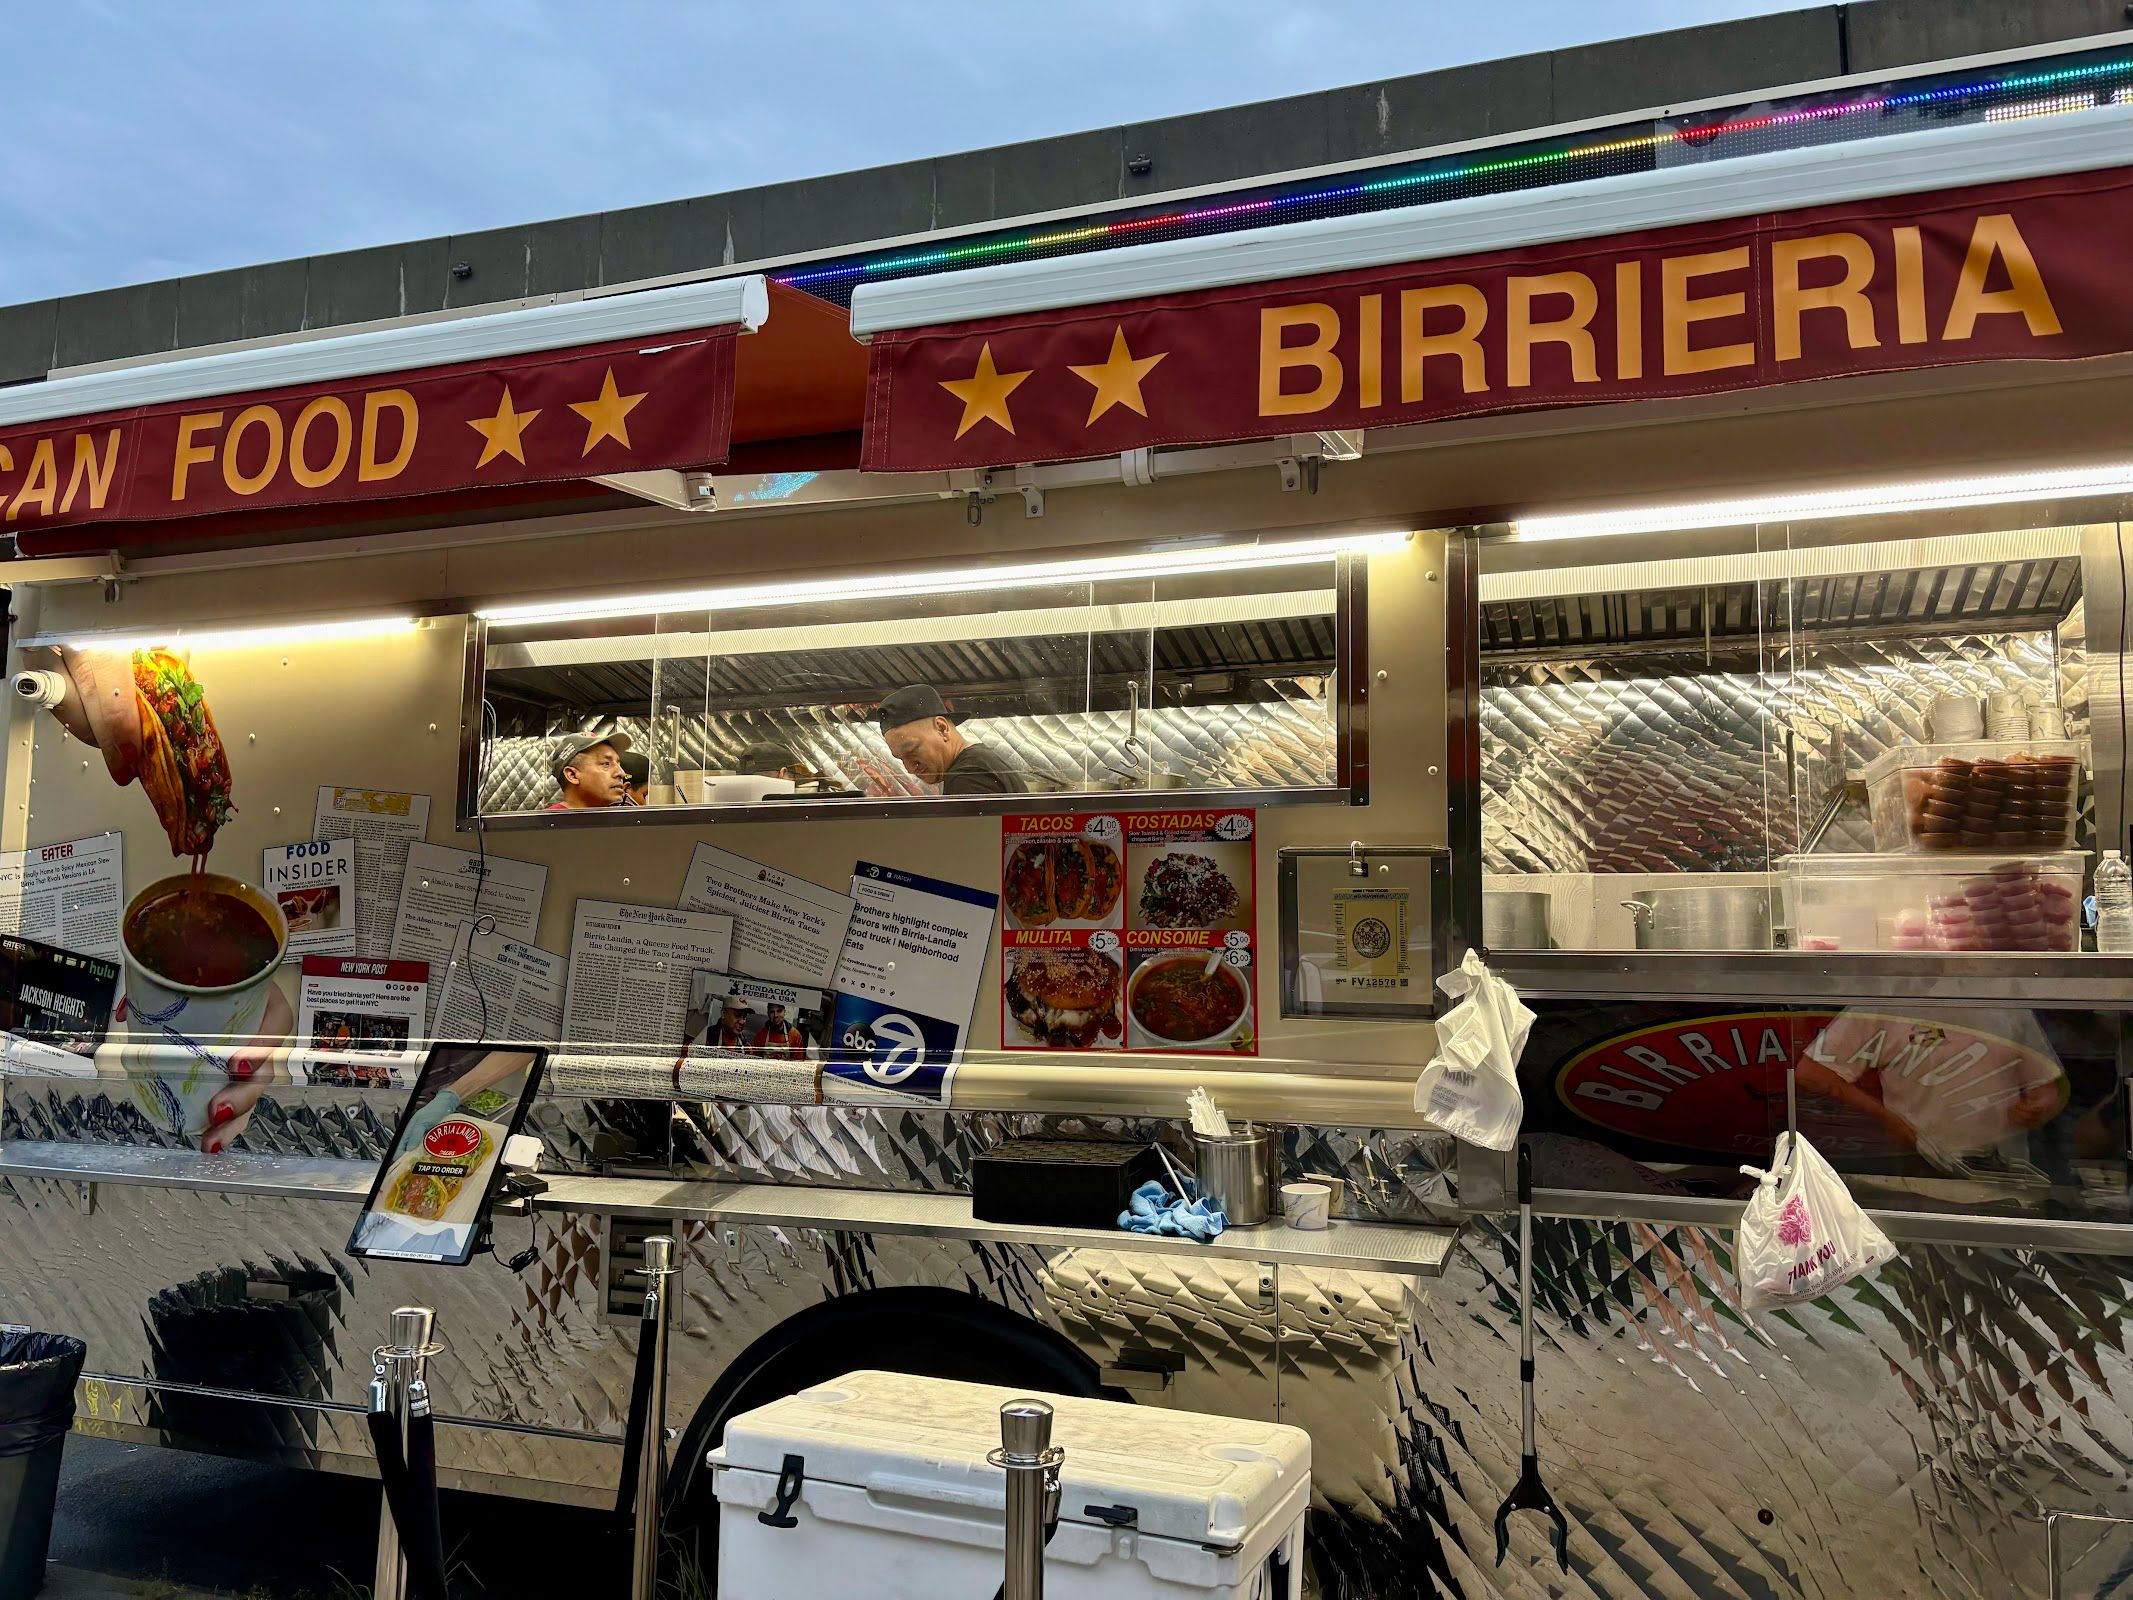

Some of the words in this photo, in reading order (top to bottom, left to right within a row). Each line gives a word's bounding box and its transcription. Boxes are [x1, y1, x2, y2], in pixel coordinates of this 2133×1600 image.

[1258, 213, 2064, 417] BIRRIERIA
[171, 388, 419, 501] FOOD
[1020, 816, 1074, 831] TACOS
[1127, 813, 1216, 830] TOSTADAS
[41, 844, 74, 861] EATER
[286, 841, 331, 860] FOOD
[61, 864, 75, 874] Spicy
[76, 859, 97, 869] Mexican
[62, 871, 82, 880] Versions
[88, 867, 96, 875] LA
[269, 857, 348, 883] INSIDER
[467, 865, 492, 877] STRET
[706, 875, 722, 888] Two
[723, 880, 758, 901] Brothers
[759, 895, 781, 910] Make
[782, 903, 800, 917] New
[802, 911, 826, 927] York's
[619, 908, 632, 918] The
[632, 909, 648, 920] New
[649, 911, 666, 923] York
[666, 913, 687, 925] Times
[739, 899, 770, 916] Juiciest
[771, 911, 796, 926] Birria
[797, 920, 821, 935] Tacos
[854, 902, 890, 919] Brothers
[892, 912, 930, 931] highlight
[932, 923, 969, 940] complex
[882, 922, 900, 935] with
[901, 927, 957, 949] Birria-Landia
[1015, 930, 1073, 944] MULITA
[1126, 930, 1211, 945] CONSOME
[589, 941, 603, 950] Has
[604, 942, 637, 955] Changed
[638, 946, 651, 955] the
[651, 949, 670, 959] Taco
[671, 951, 711, 964] Landscape
[642, 938, 670, 950] Queens
[671, 942, 689, 952] Food
[845, 938, 864, 951] Eats
[848, 926, 868, 939] food
[869, 931, 891, 945] truck
[898, 939, 960, 963] Neighborhood
[89, 960, 115, 979] hulu
[340, 961, 354, 973] NEW
[354, 962, 371, 974] YORK
[371, 963, 388, 975] POST
[307, 988, 322, 997] Have
[322, 990, 333, 998] you
[347, 991, 363, 999] birria
[362, 992, 376, 1000] yet?
[376, 993, 390, 1001] Here
[400, 994, 411, 1002] the
[741, 989, 776, 1002] PUEBLA
[777, 993, 797, 1004] USA
[742, 981, 798, 998] FUNDACIÓN
[19, 984, 54, 1009] JACKSON
[53, 992, 86, 1019] HEIGHTS
[306, 996, 319, 1004] best
[319, 997, 339, 1005] places
[345, 998, 355, 1006] get
[842, 1027, 877, 1053] abc
[863, 1013, 926, 1085] 7
[418, 1164, 431, 1172] TAP
[431, 1165, 441, 1173] TO
[441, 1166, 464, 1175] ORDER
[1816, 1240, 1836, 1265] YOU
